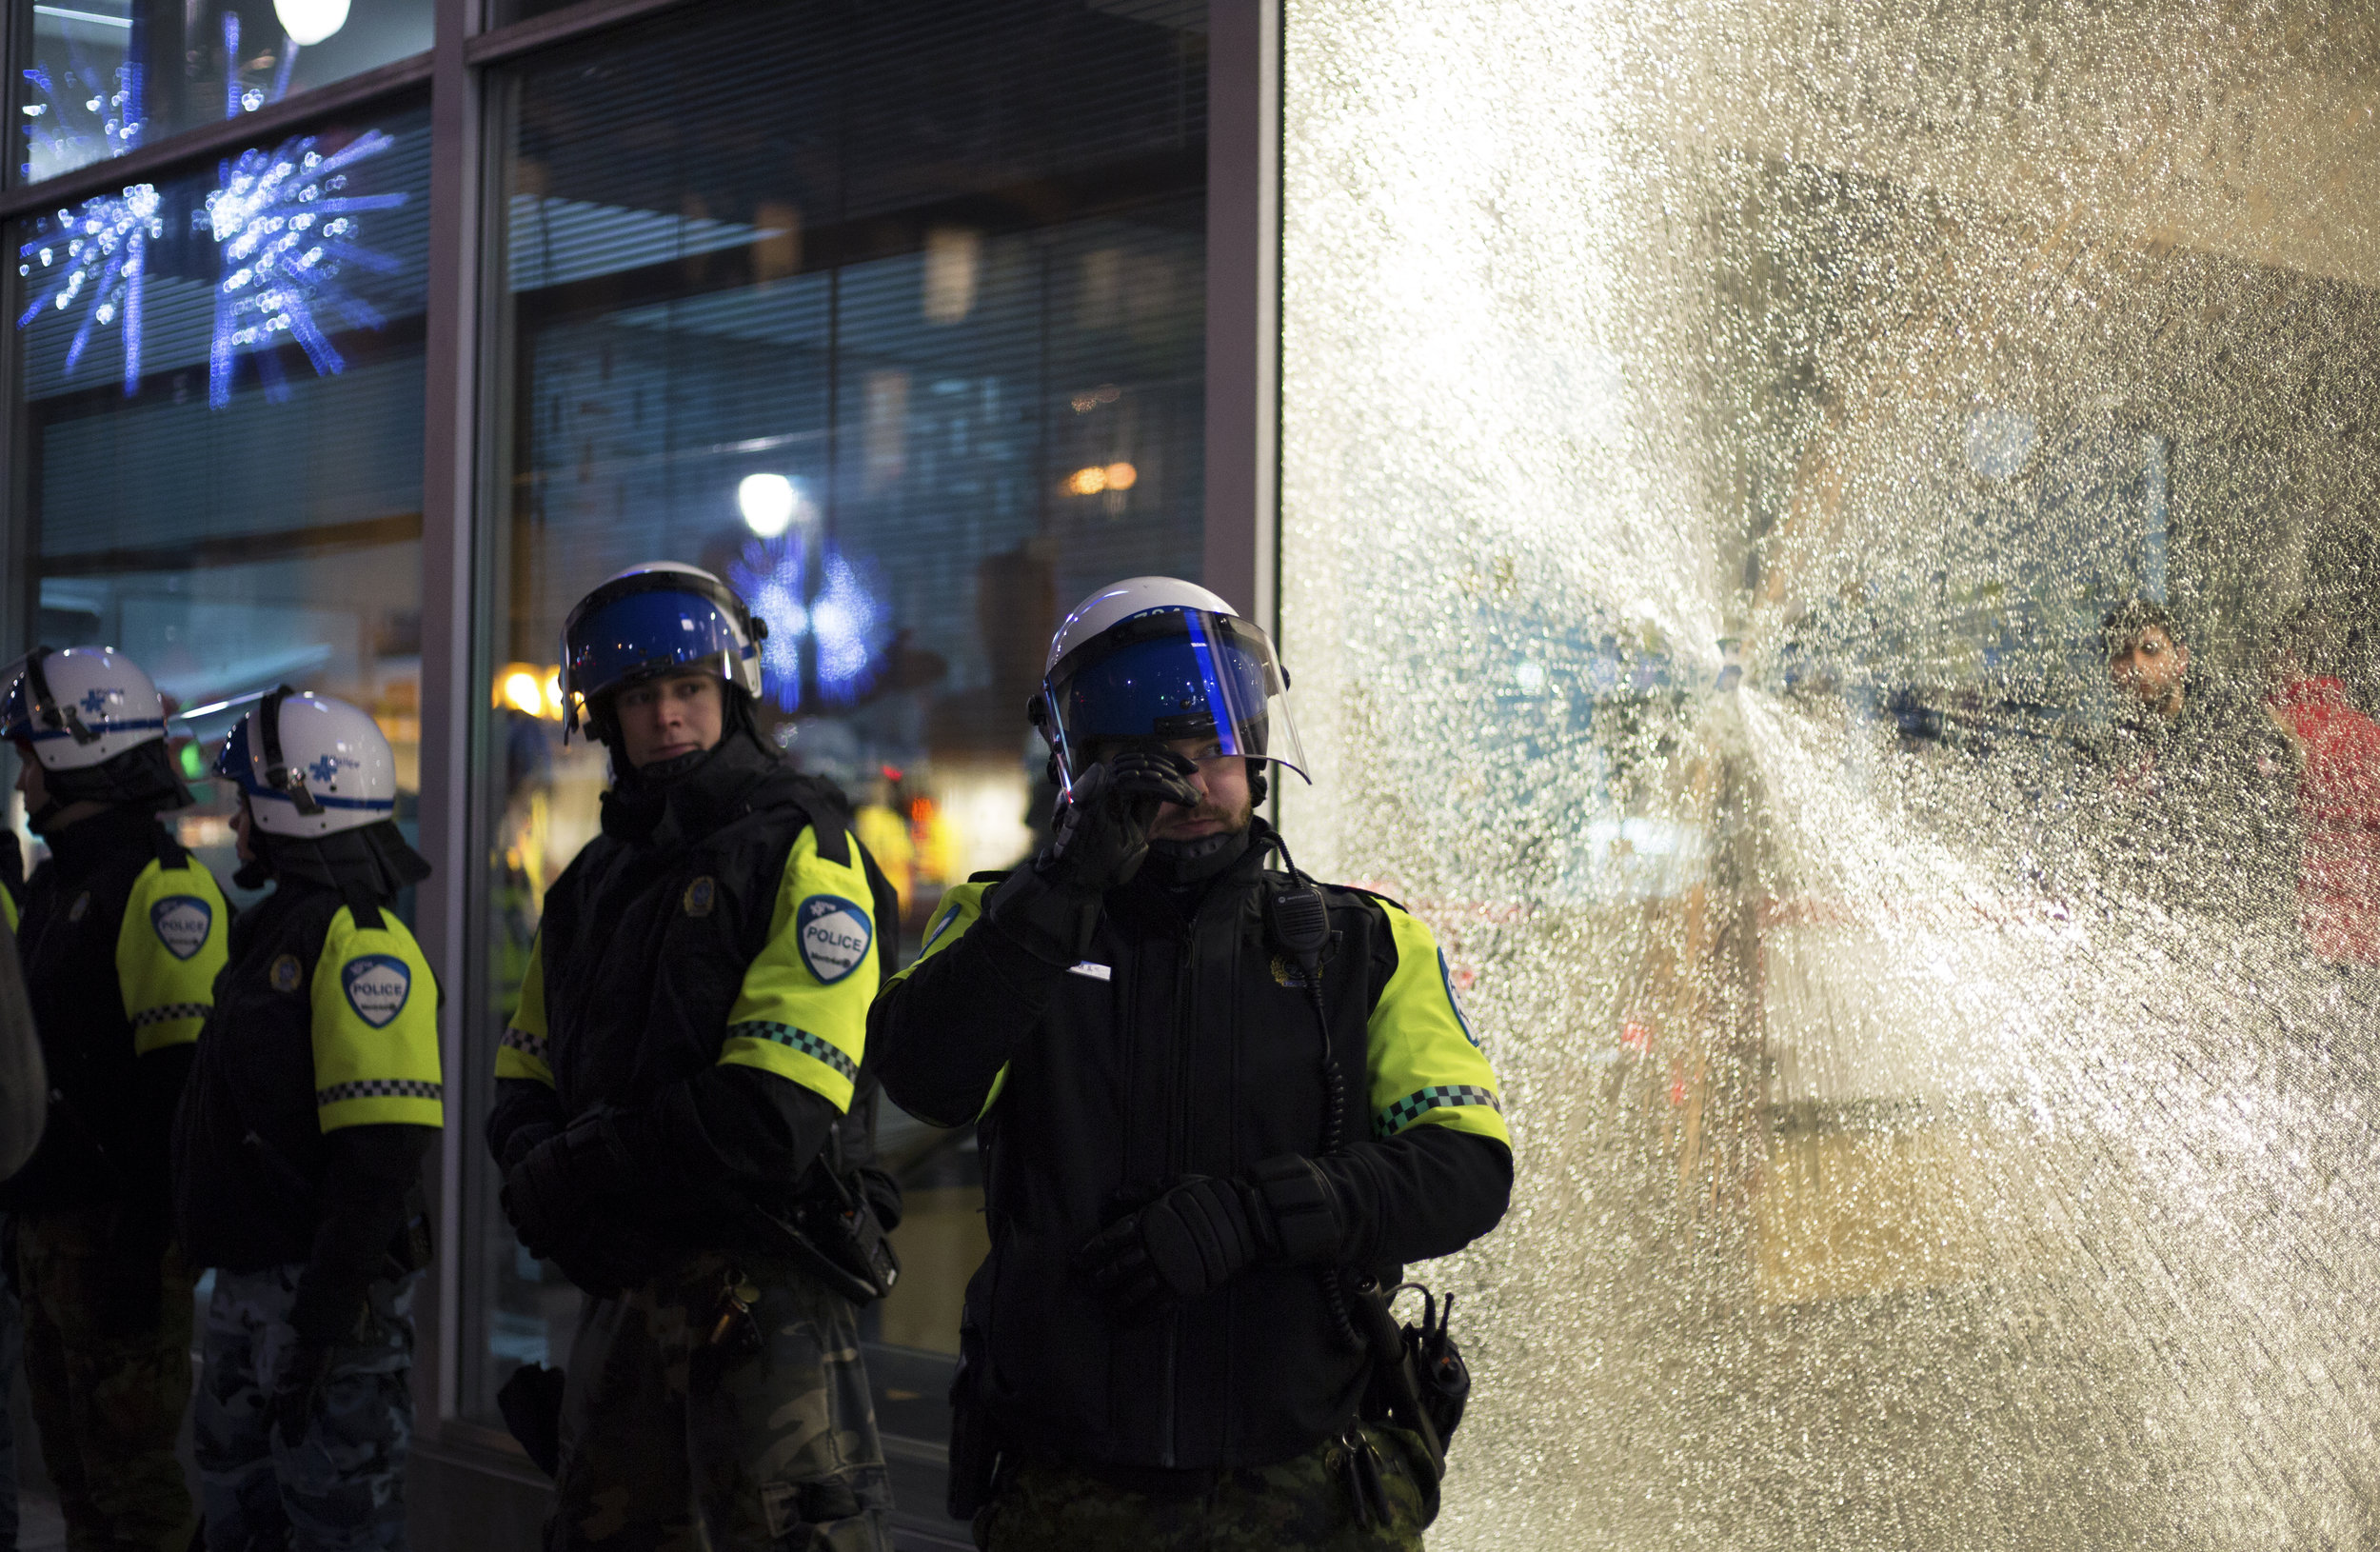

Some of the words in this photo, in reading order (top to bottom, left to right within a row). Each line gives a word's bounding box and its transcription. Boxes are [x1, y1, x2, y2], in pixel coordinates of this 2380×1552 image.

[162, 920, 204, 931] POLICE
[807, 926, 863, 953] POLICE
[353, 983, 402, 996] POLICE
